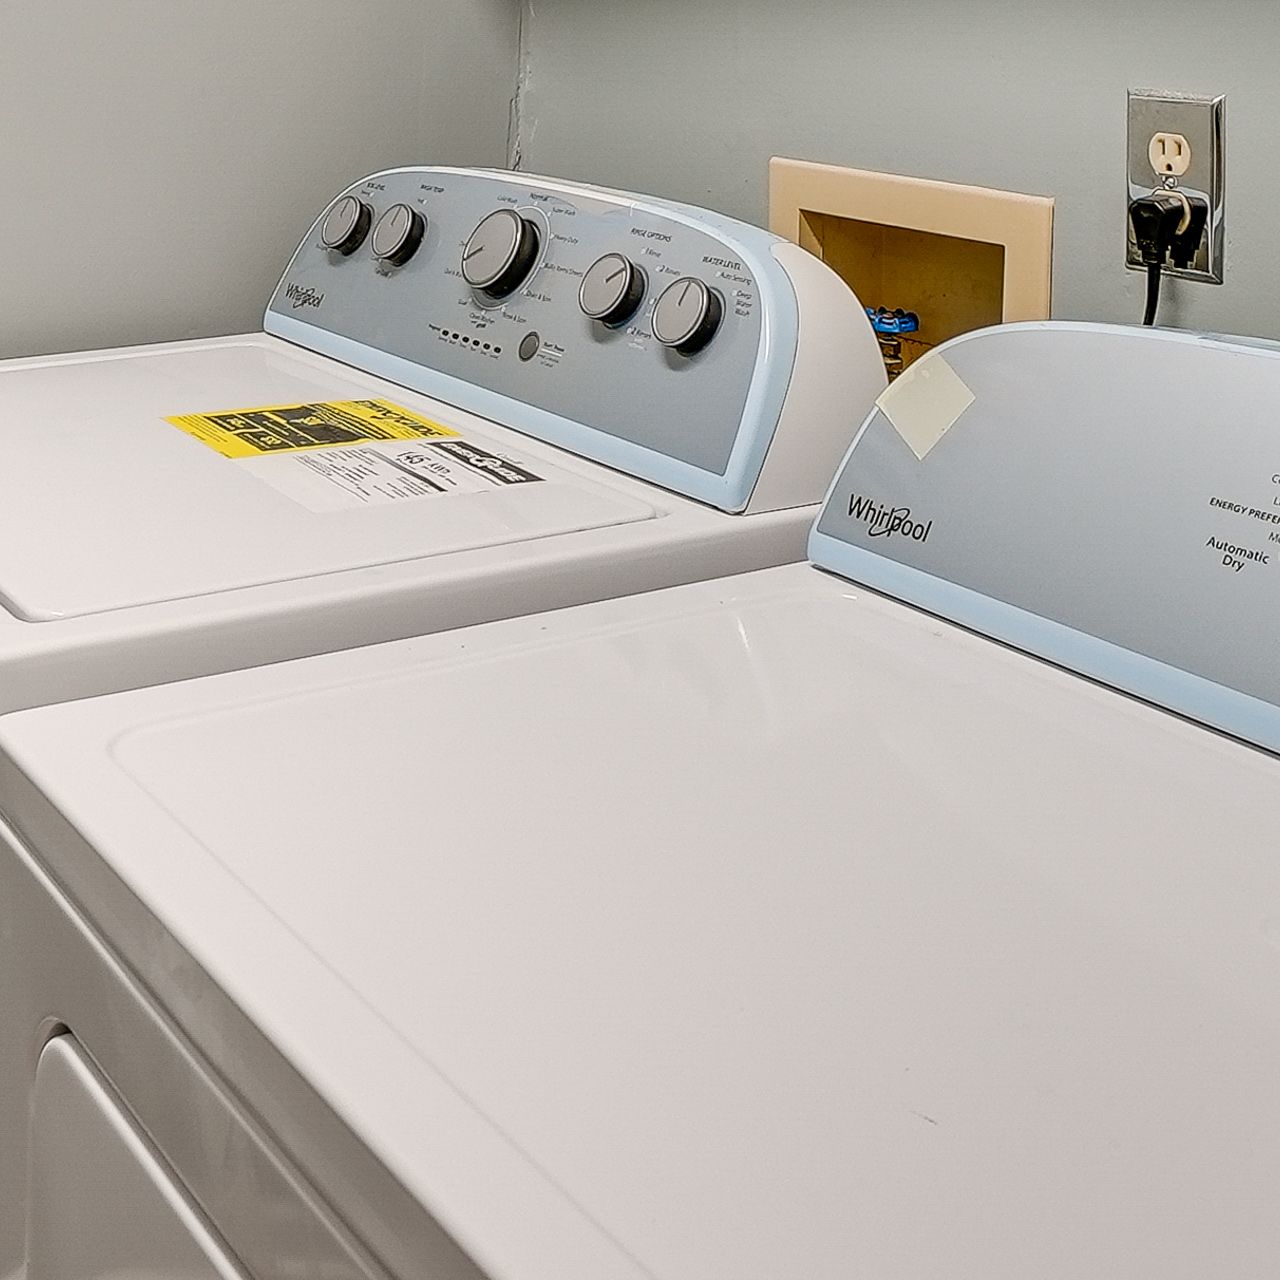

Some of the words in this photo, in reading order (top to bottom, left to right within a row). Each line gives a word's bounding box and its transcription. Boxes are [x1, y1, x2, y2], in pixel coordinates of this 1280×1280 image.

[1209, 497, 1248, 515] ENERGY
[847, 493, 933, 543] Whirlpool
[1206, 536, 1270, 565] Automatic
[1222, 554, 1245, 572] Dry
